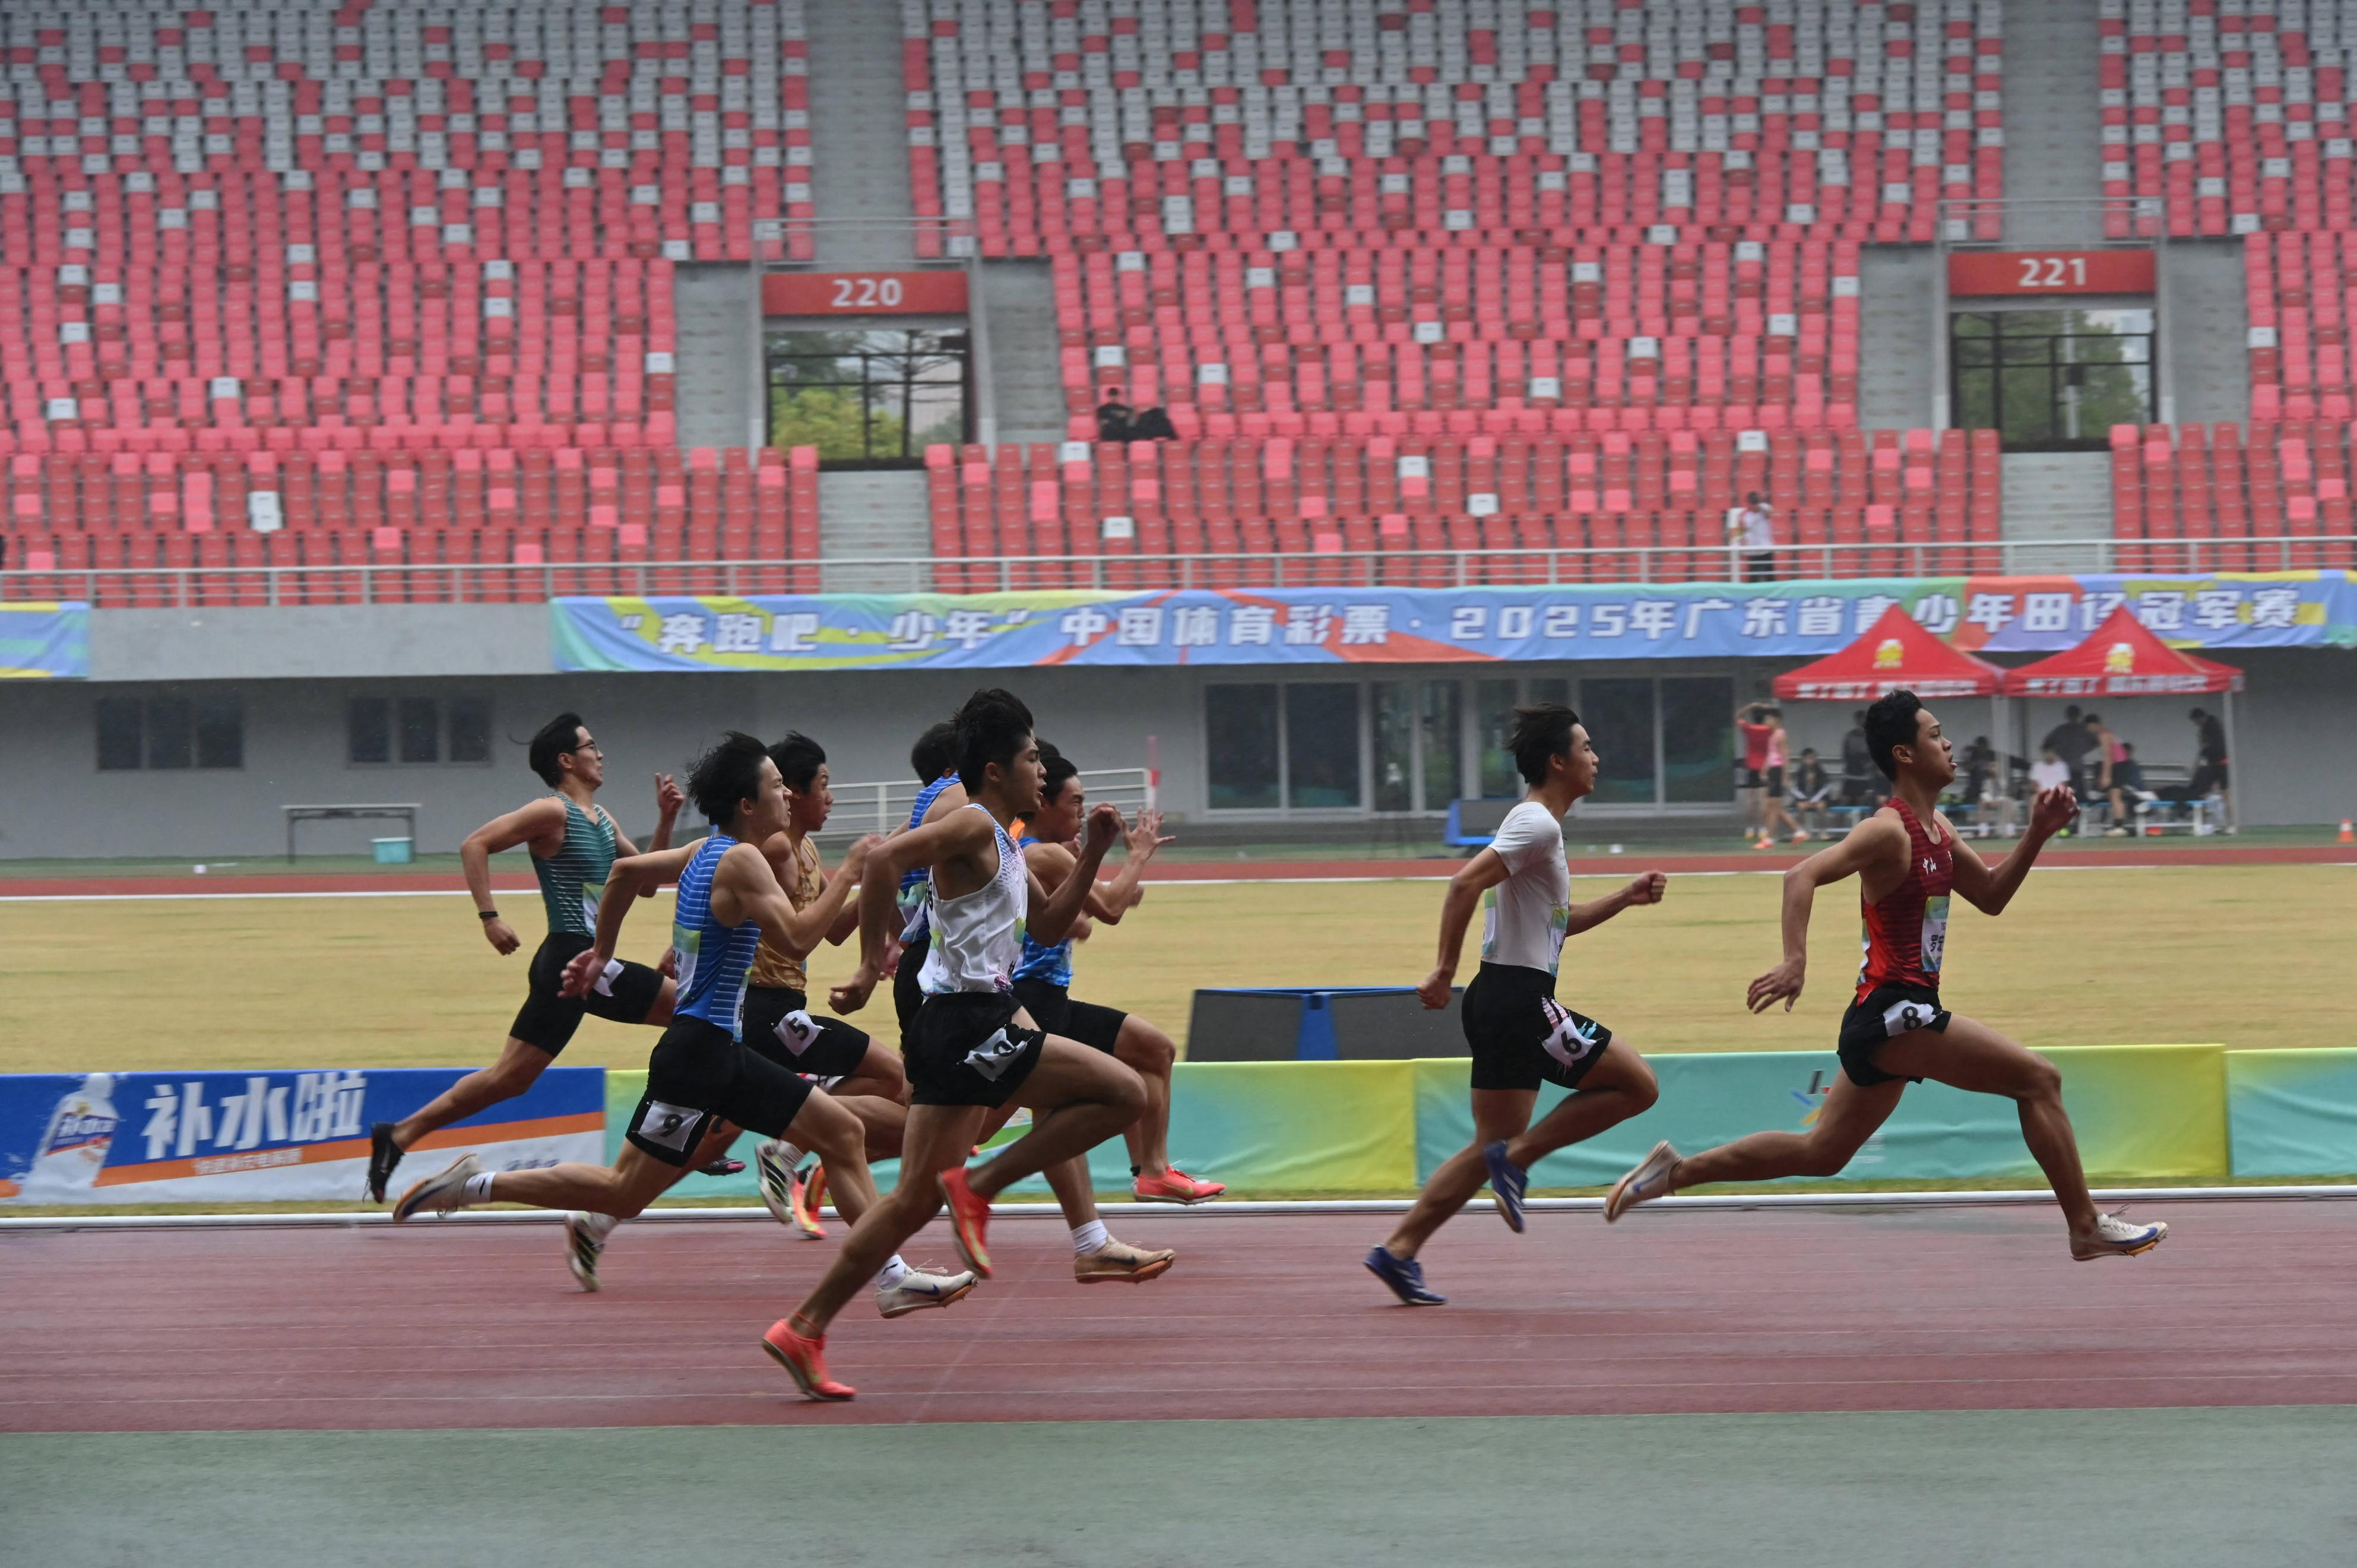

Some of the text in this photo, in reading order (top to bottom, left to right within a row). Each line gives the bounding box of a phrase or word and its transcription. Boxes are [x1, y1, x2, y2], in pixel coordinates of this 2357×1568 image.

[2019, 258, 2086, 286] 221
[831, 278, 902, 307] 220
[787, 1017, 810, 1041] 5
[1902, 1005, 1922, 1031] 8
[1561, 1030, 1582, 1054] 6
[140, 1070, 368, 1160] 补水啦
[658, 1113, 684, 1138] 9
